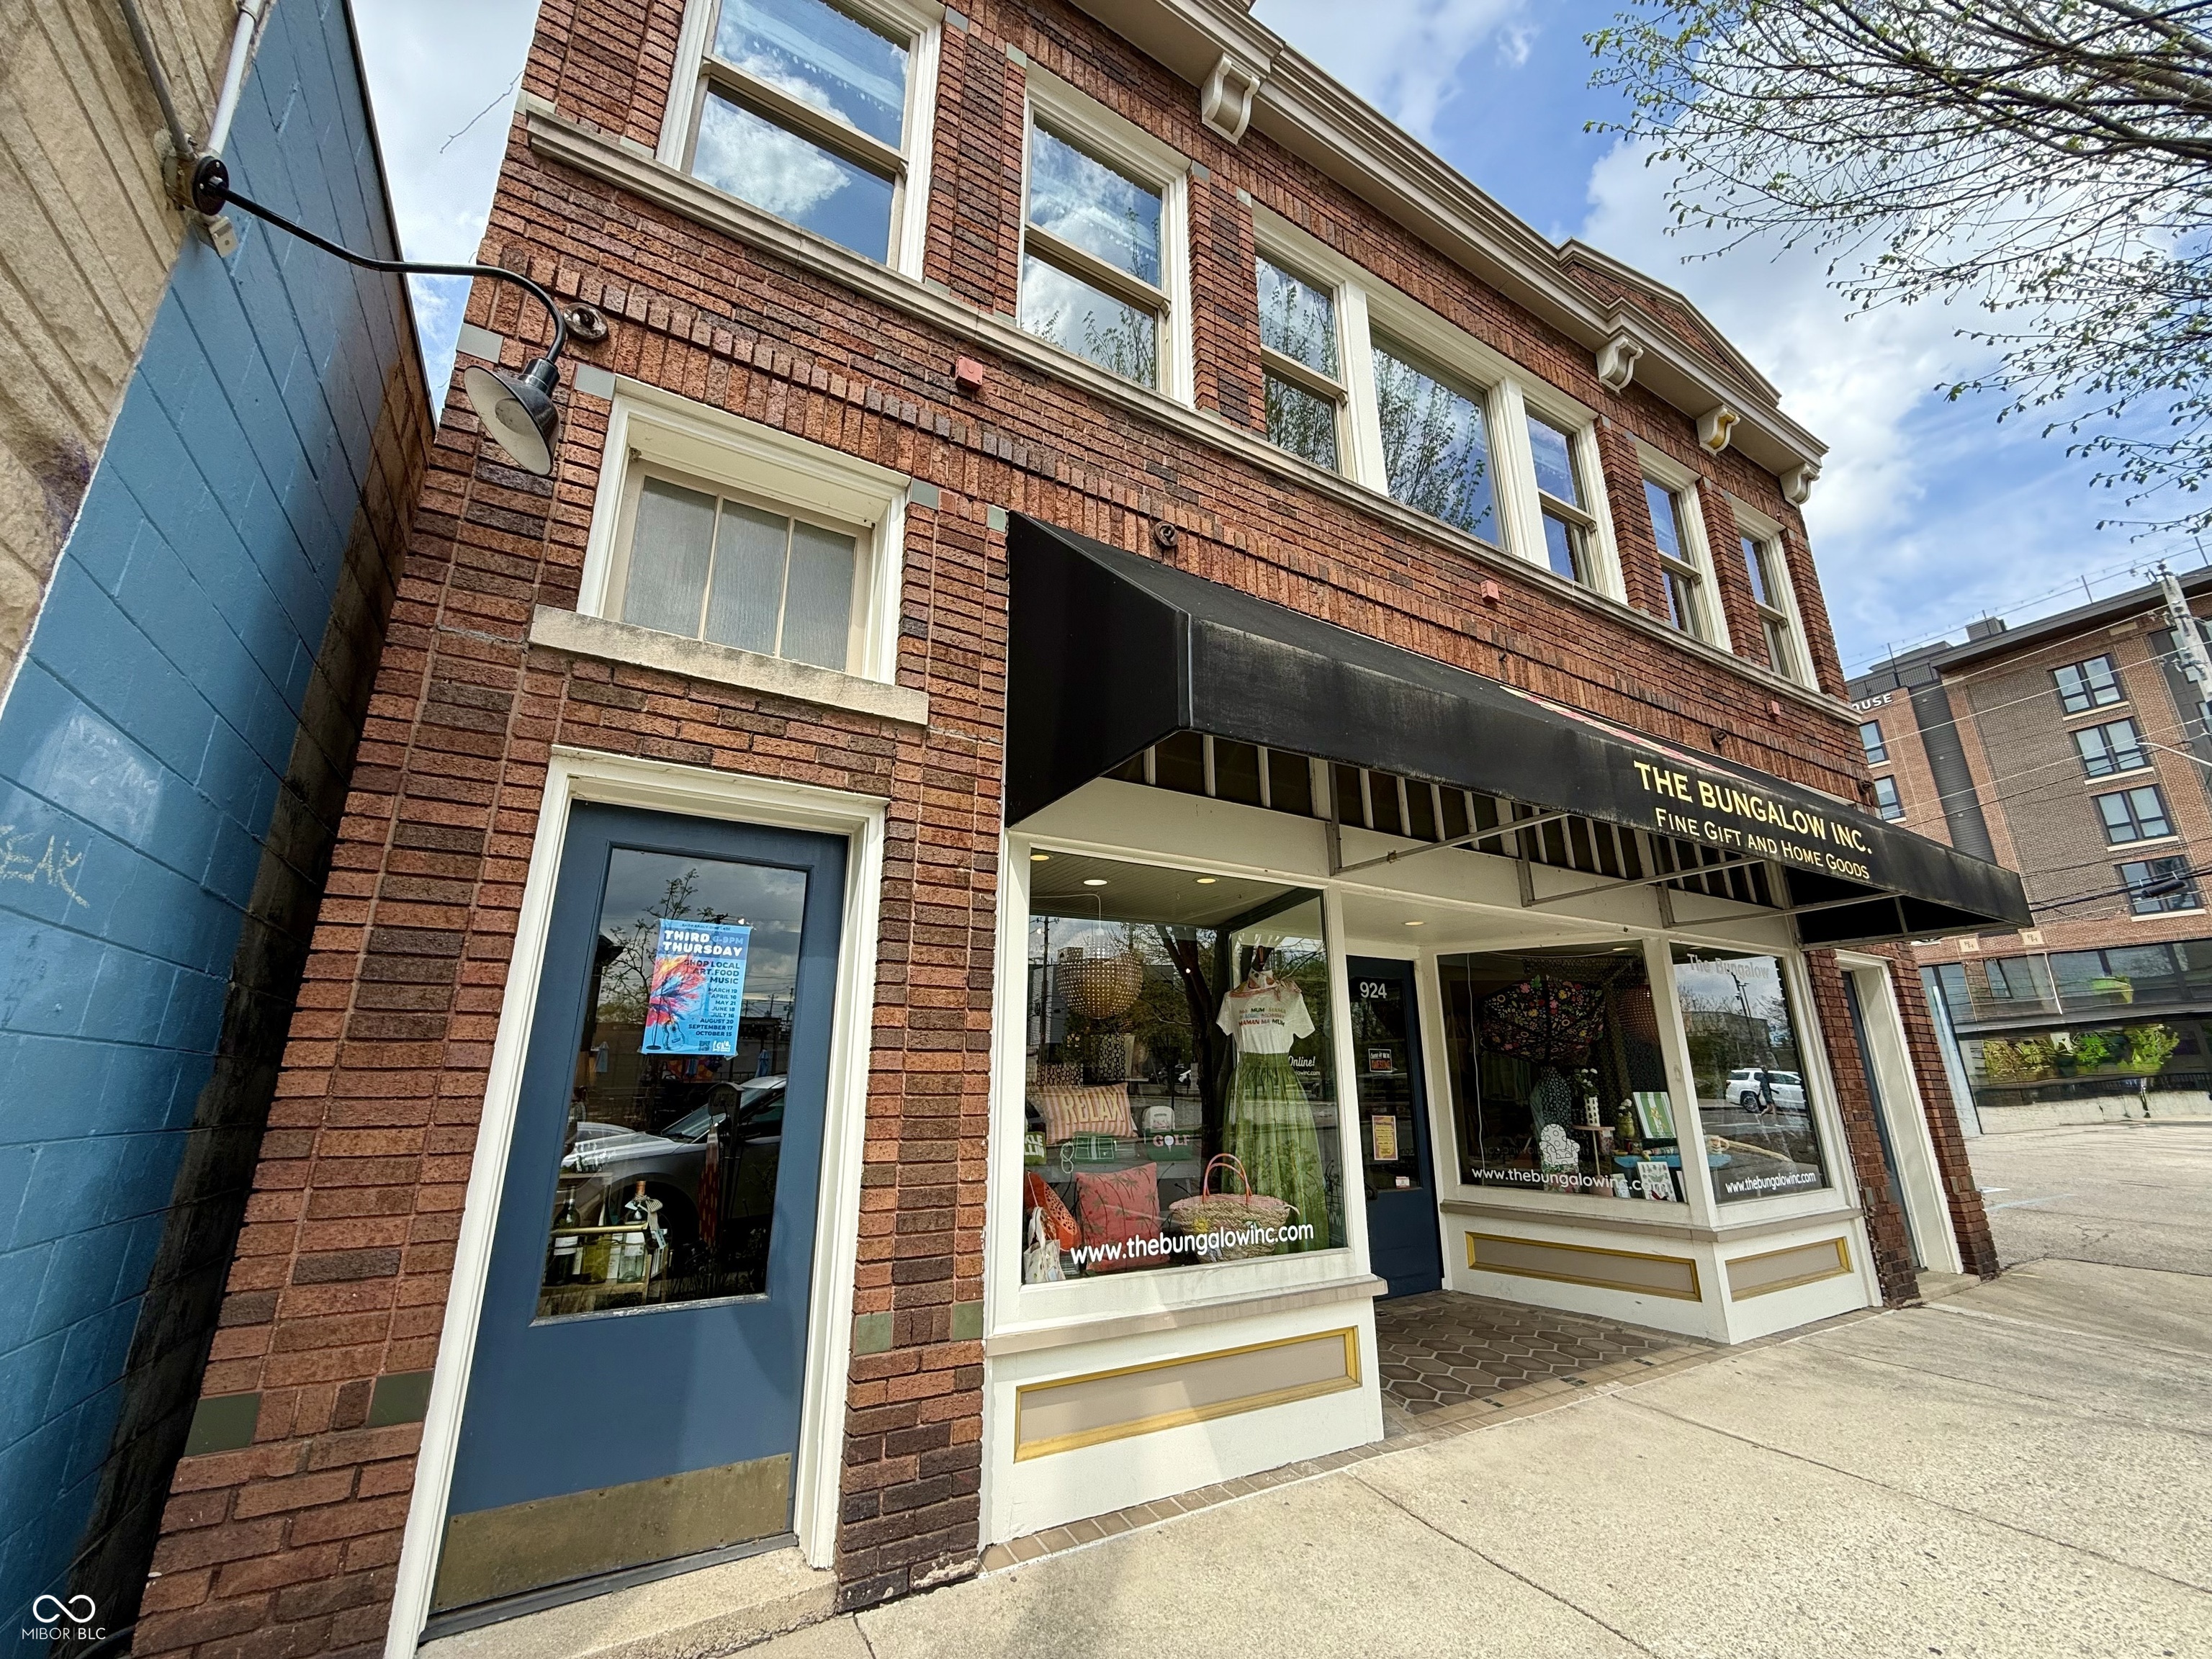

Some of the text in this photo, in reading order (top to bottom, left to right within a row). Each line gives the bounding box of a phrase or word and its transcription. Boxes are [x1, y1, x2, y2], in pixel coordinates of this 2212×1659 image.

[1633, 760, 1873, 855] THE BUNGALOW INC.
[1655, 807, 1870, 880] FINE GIFT AND HOME GOODS
[664, 930, 710, 943] THIRD
[662, 941, 742, 956] THURSDAY
[1686, 953, 1769, 980] The Bungalow
[1359, 981, 1388, 999] 924
[1288, 1055, 1316, 1067] Online!
[1060, 1088, 1125, 1125] RELAX
[1153, 1134, 1190, 1148] GOLF
[1471, 1168, 1668, 1192] www.thebungalowinc.com
[1725, 1172, 1817, 1194] www.thebungalowinc.com
[1070, 1223, 1314, 1265] www.thebungalowinc.com
